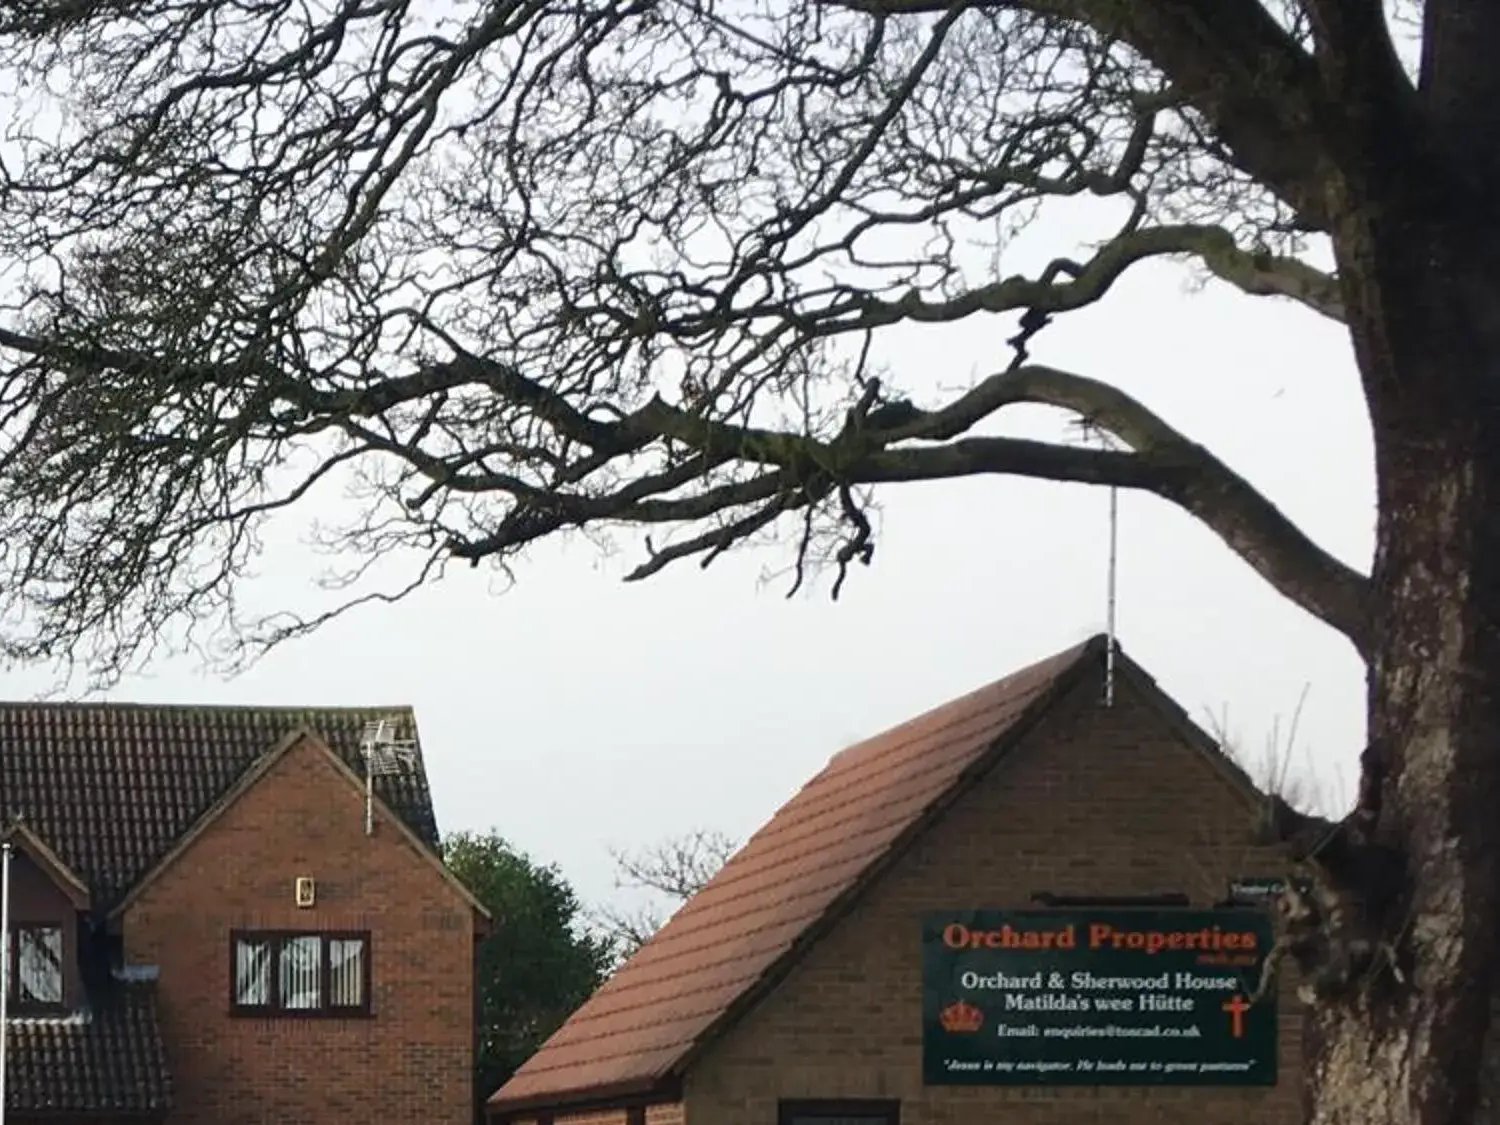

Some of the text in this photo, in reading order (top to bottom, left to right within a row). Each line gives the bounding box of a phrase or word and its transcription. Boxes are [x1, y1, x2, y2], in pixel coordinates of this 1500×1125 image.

[943, 923, 1257, 955] Orchard Properties
[961, 971, 1237, 989] Orchard & Sherwood House
[1005, 993, 1194, 1011] Matilda's wee Hütte
[997, 1024, 1039, 1037] Email:
